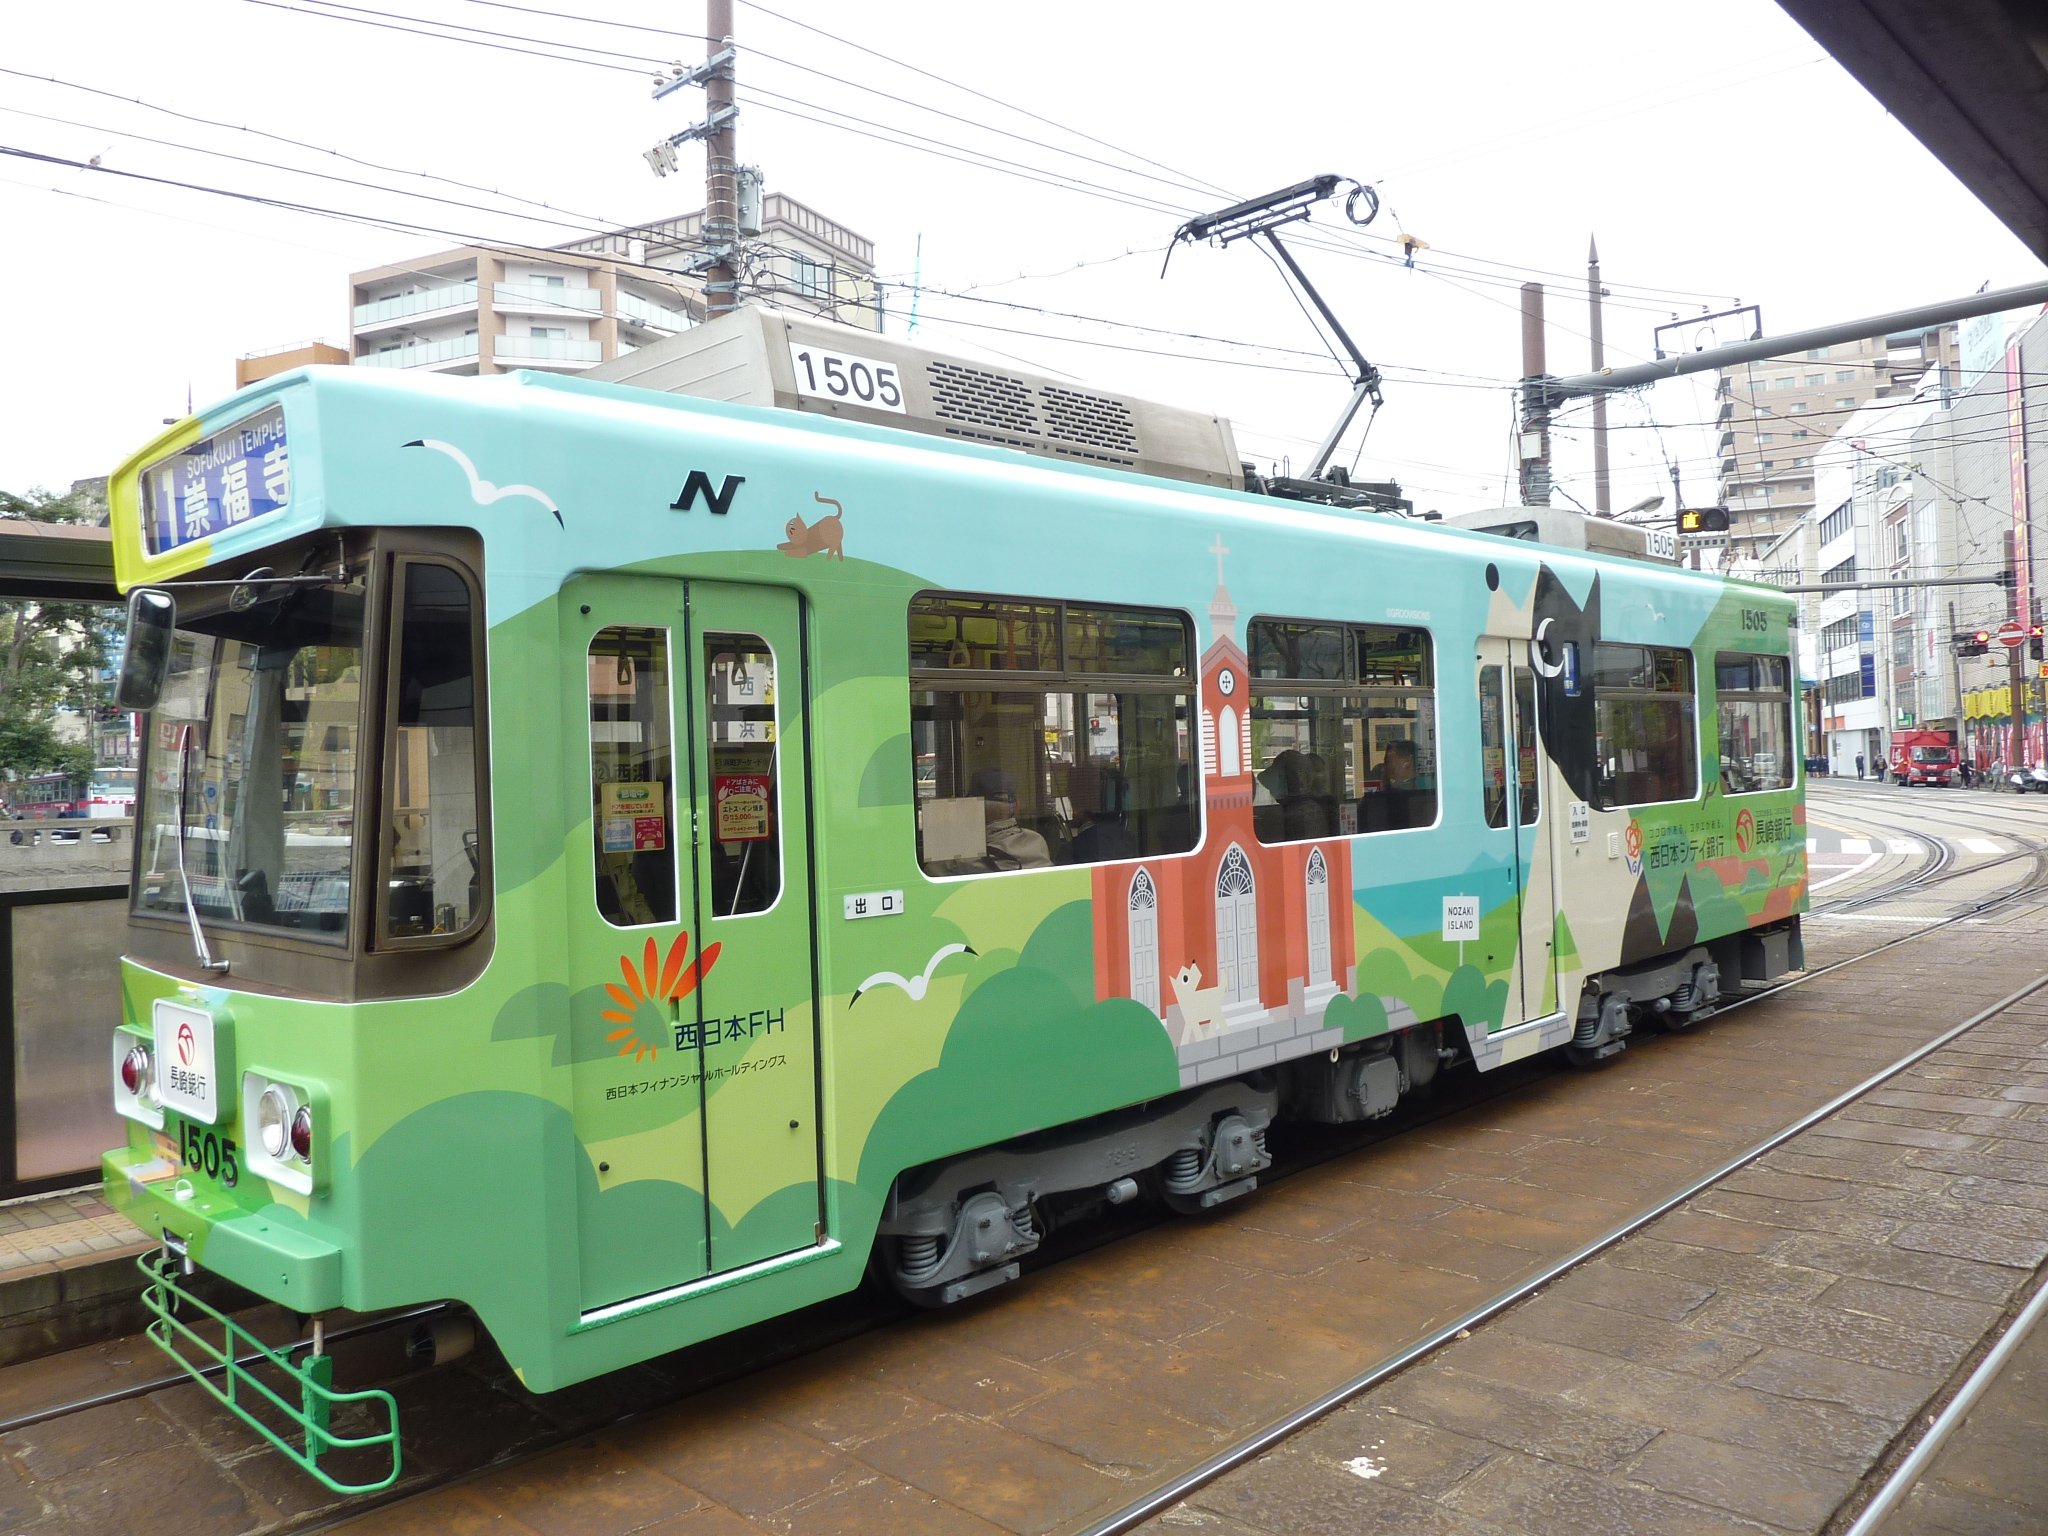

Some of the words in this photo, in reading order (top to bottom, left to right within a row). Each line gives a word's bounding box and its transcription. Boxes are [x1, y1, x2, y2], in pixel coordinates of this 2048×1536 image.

[798, 352, 901, 407] 1505
[186, 439, 237, 480] SOFUKUJI
[239, 417, 284, 455] TEMPLE
[183, 443, 290, 539] 崇福寺
[1647, 532, 1675, 557] 1505
[1741, 608, 1768, 631] 1505
[1572, 805, 1586, 816] 入口
[1756, 817, 1792, 845] 長崎銀行
[1649, 835, 1724, 869] 西日本シティ銀行
[855, 896, 893, 915] 出口
[1448, 906, 1474, 916] NOZAKI
[1448, 920, 1474, 930] ISLAND
[674, 1007, 785, 1052] 西日本FH
[170, 1065, 206, 1100] 長崎銀行
[605, 1054, 787, 1100] 西日本フィナンシャルホールディングス
[179, 1119, 239, 1188] 1505
